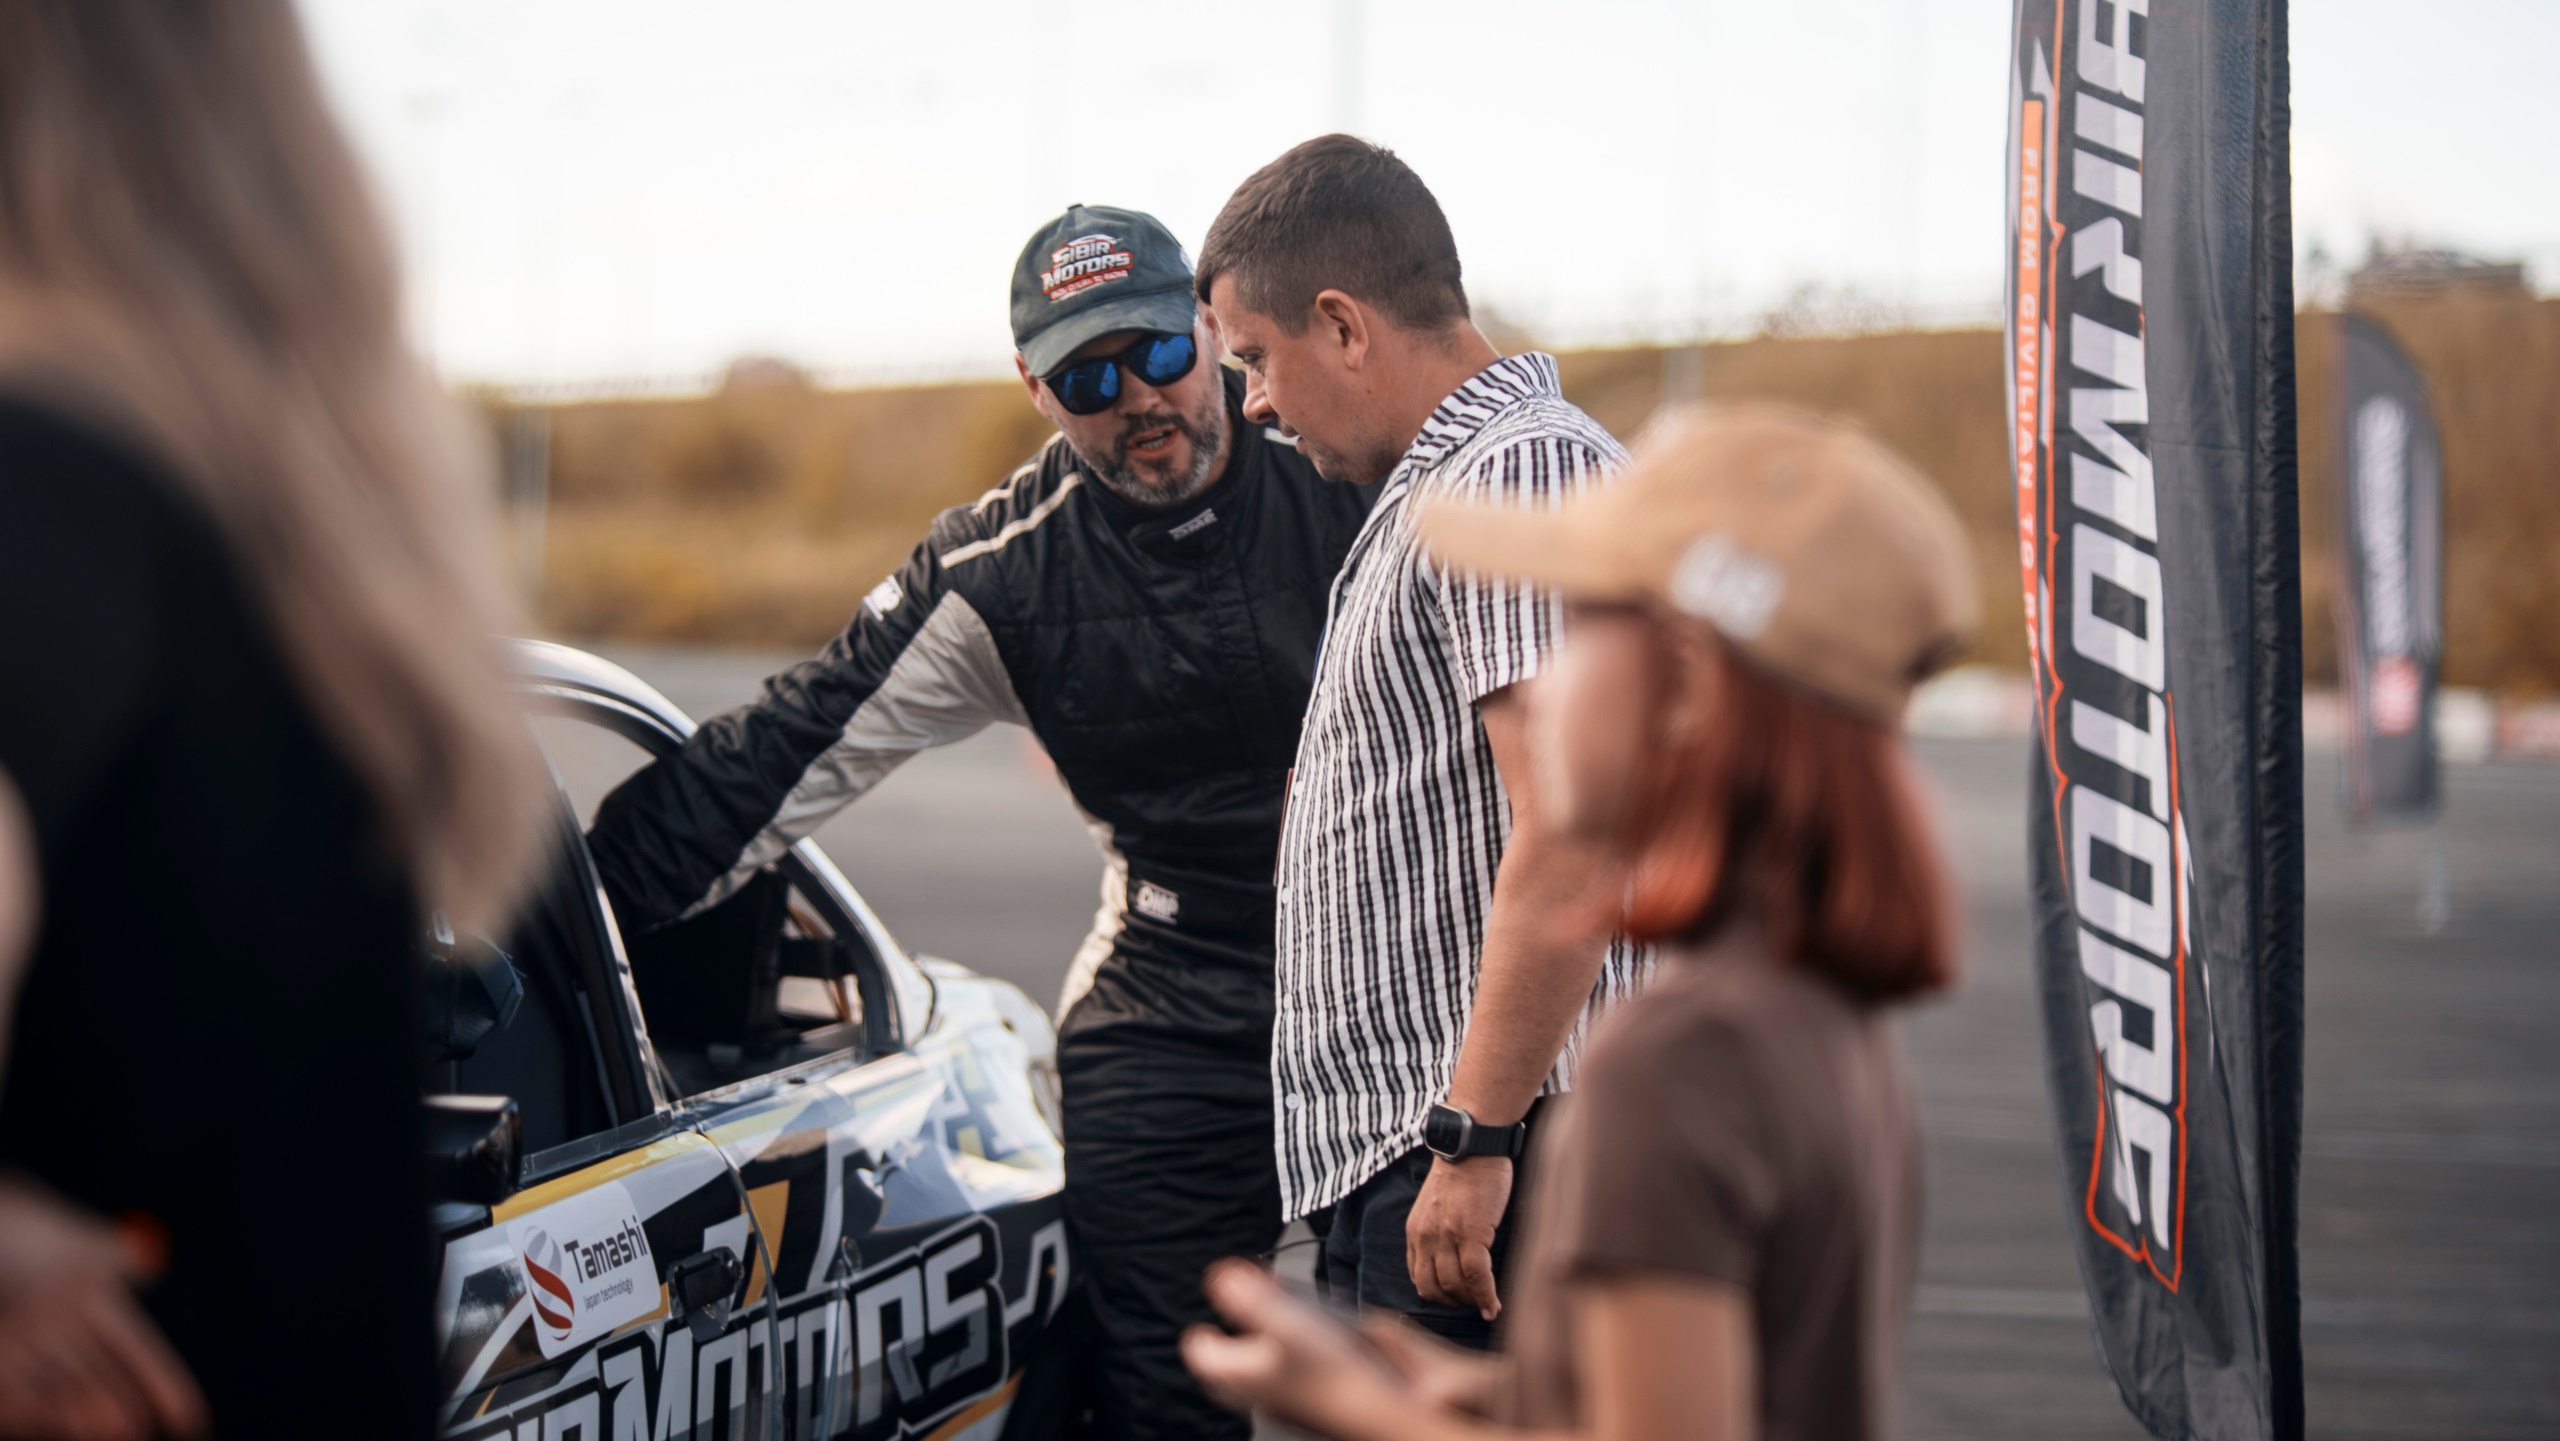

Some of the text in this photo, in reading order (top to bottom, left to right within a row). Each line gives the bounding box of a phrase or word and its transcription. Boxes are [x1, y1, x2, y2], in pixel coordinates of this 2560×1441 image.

[2020, 147, 2038, 269] FROM
[1041, 252, 1130, 292] MOTORS
[1051, 242, 1111, 264] SIBIR
[2018, 292, 2037, 490] CIVILIAN
[2020, 513, 2036, 569] TO
[563, 1215, 648, 1284] Tamashi
